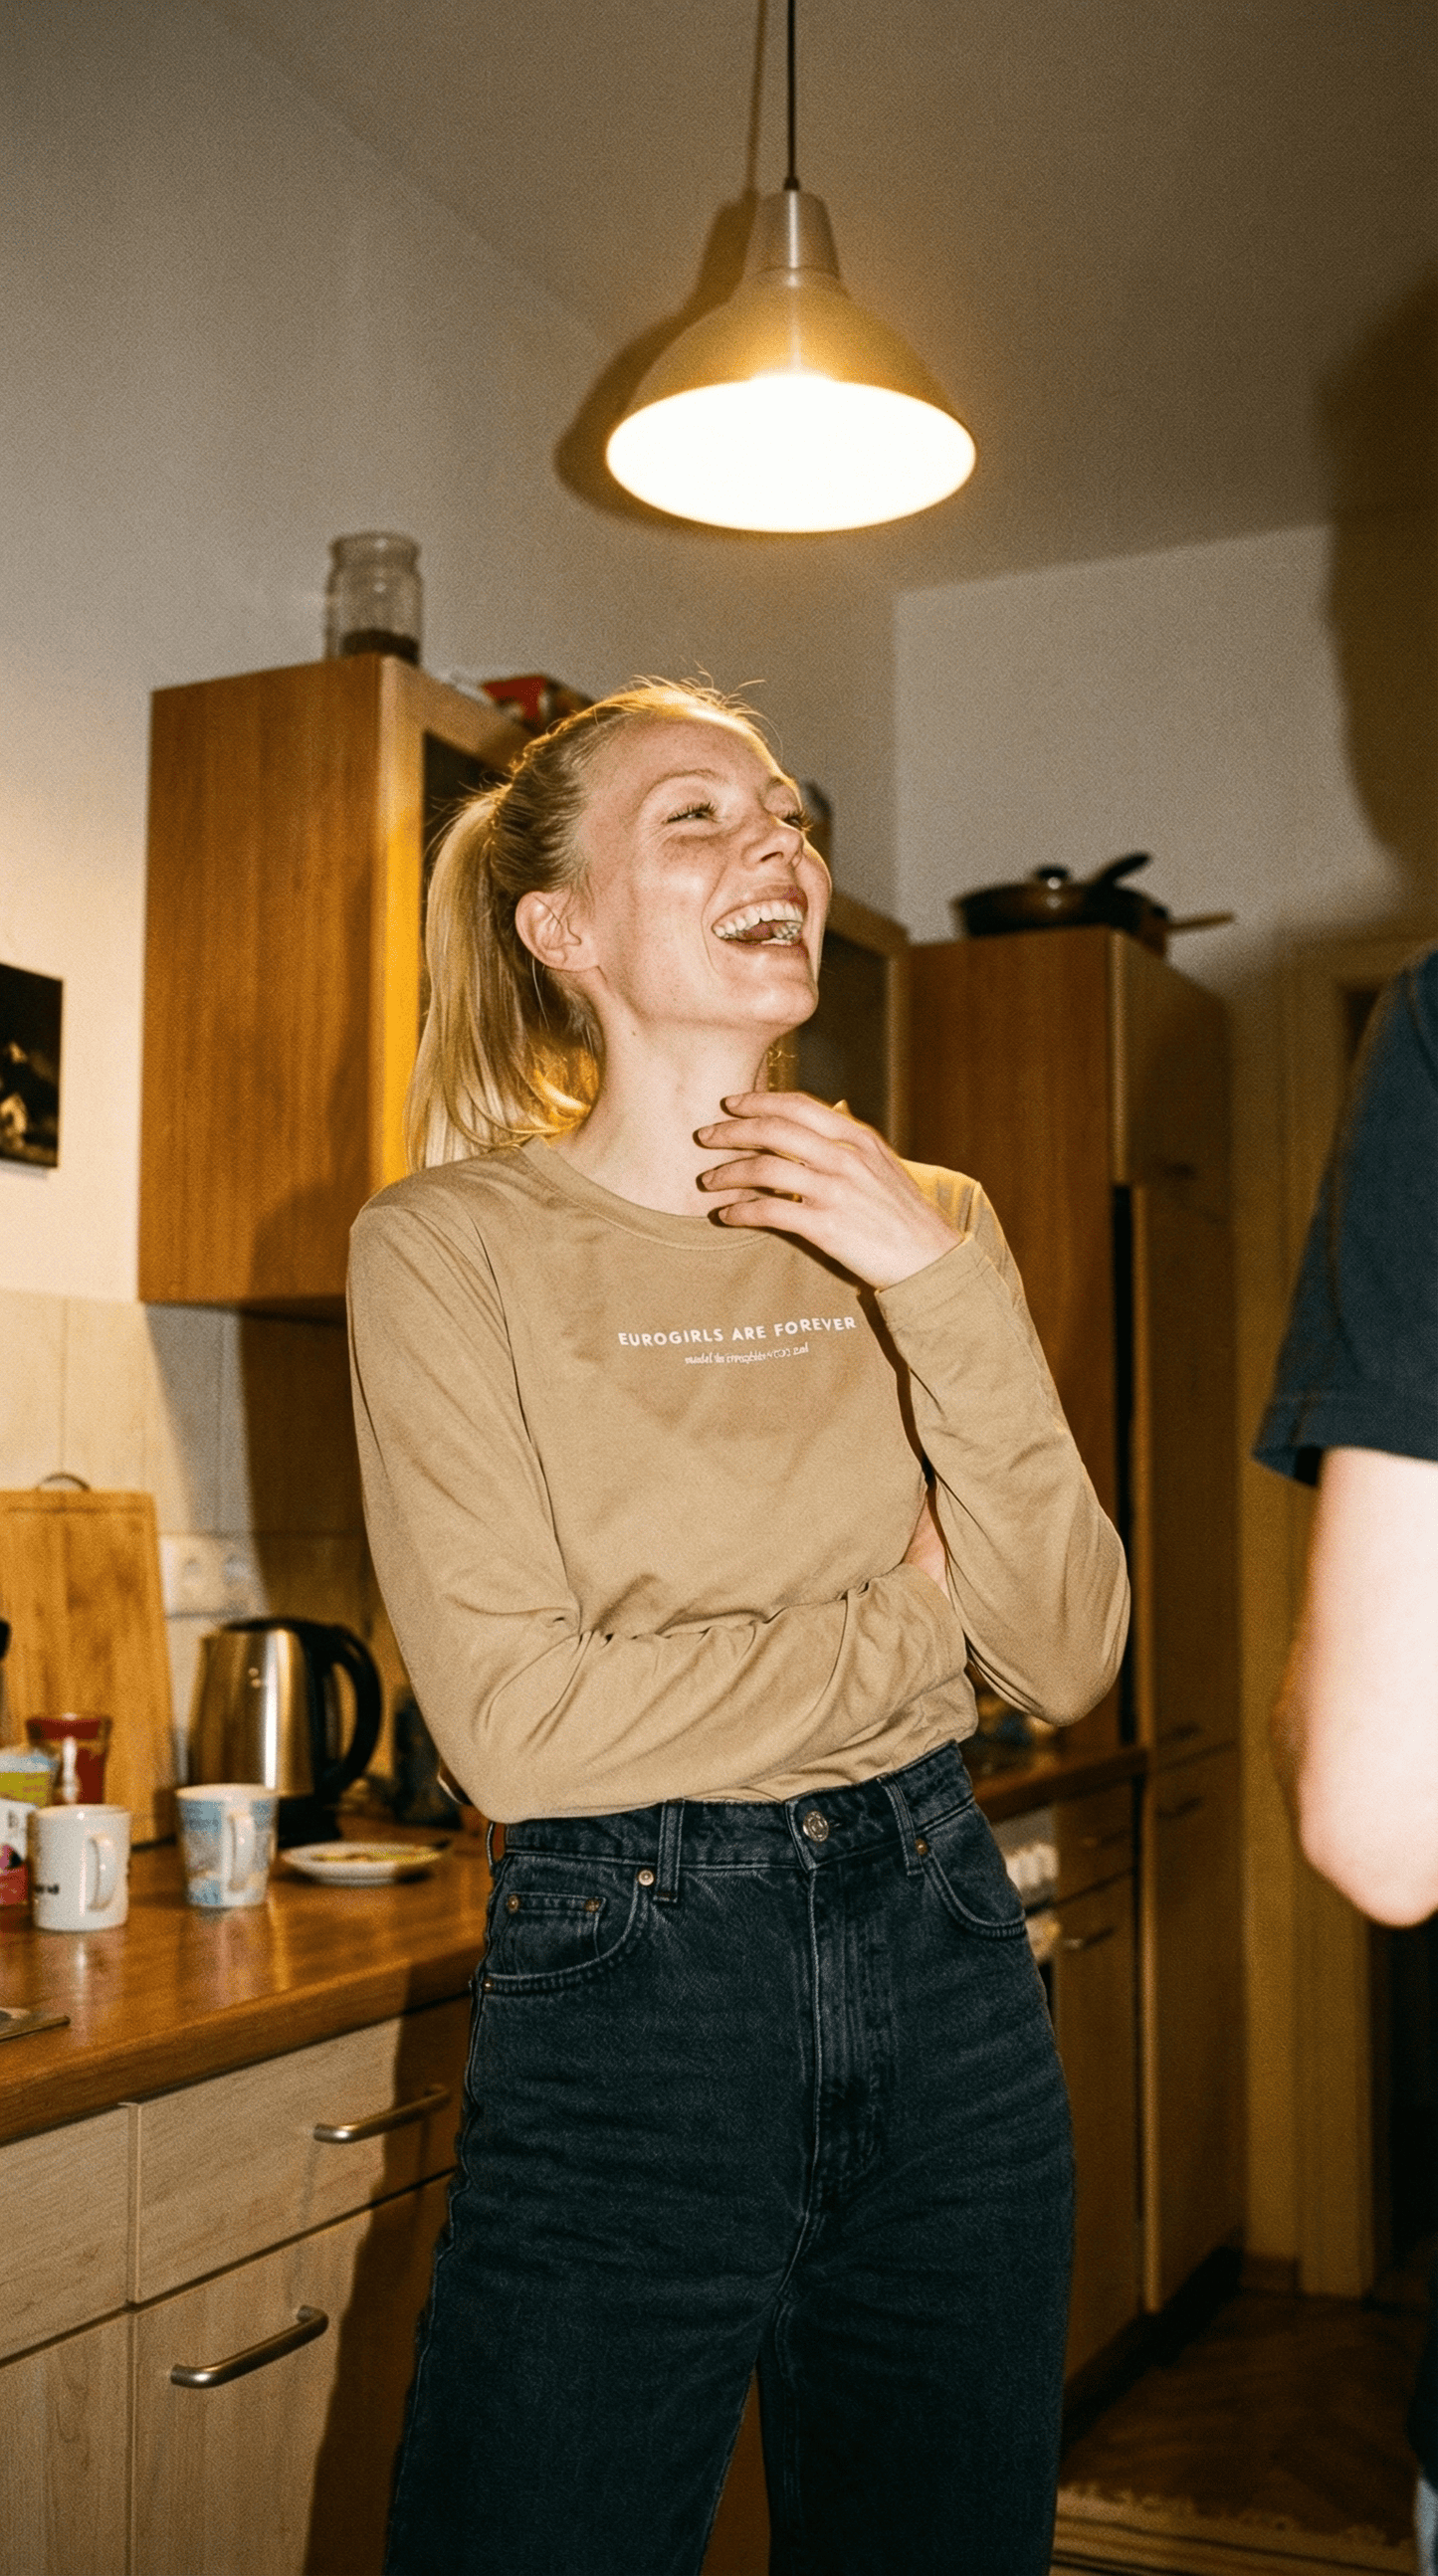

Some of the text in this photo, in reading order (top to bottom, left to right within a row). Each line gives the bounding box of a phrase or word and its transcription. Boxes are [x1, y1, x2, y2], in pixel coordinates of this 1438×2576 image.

[618, 1316, 857, 1347] EUROGIRLS ARE FOREVER
